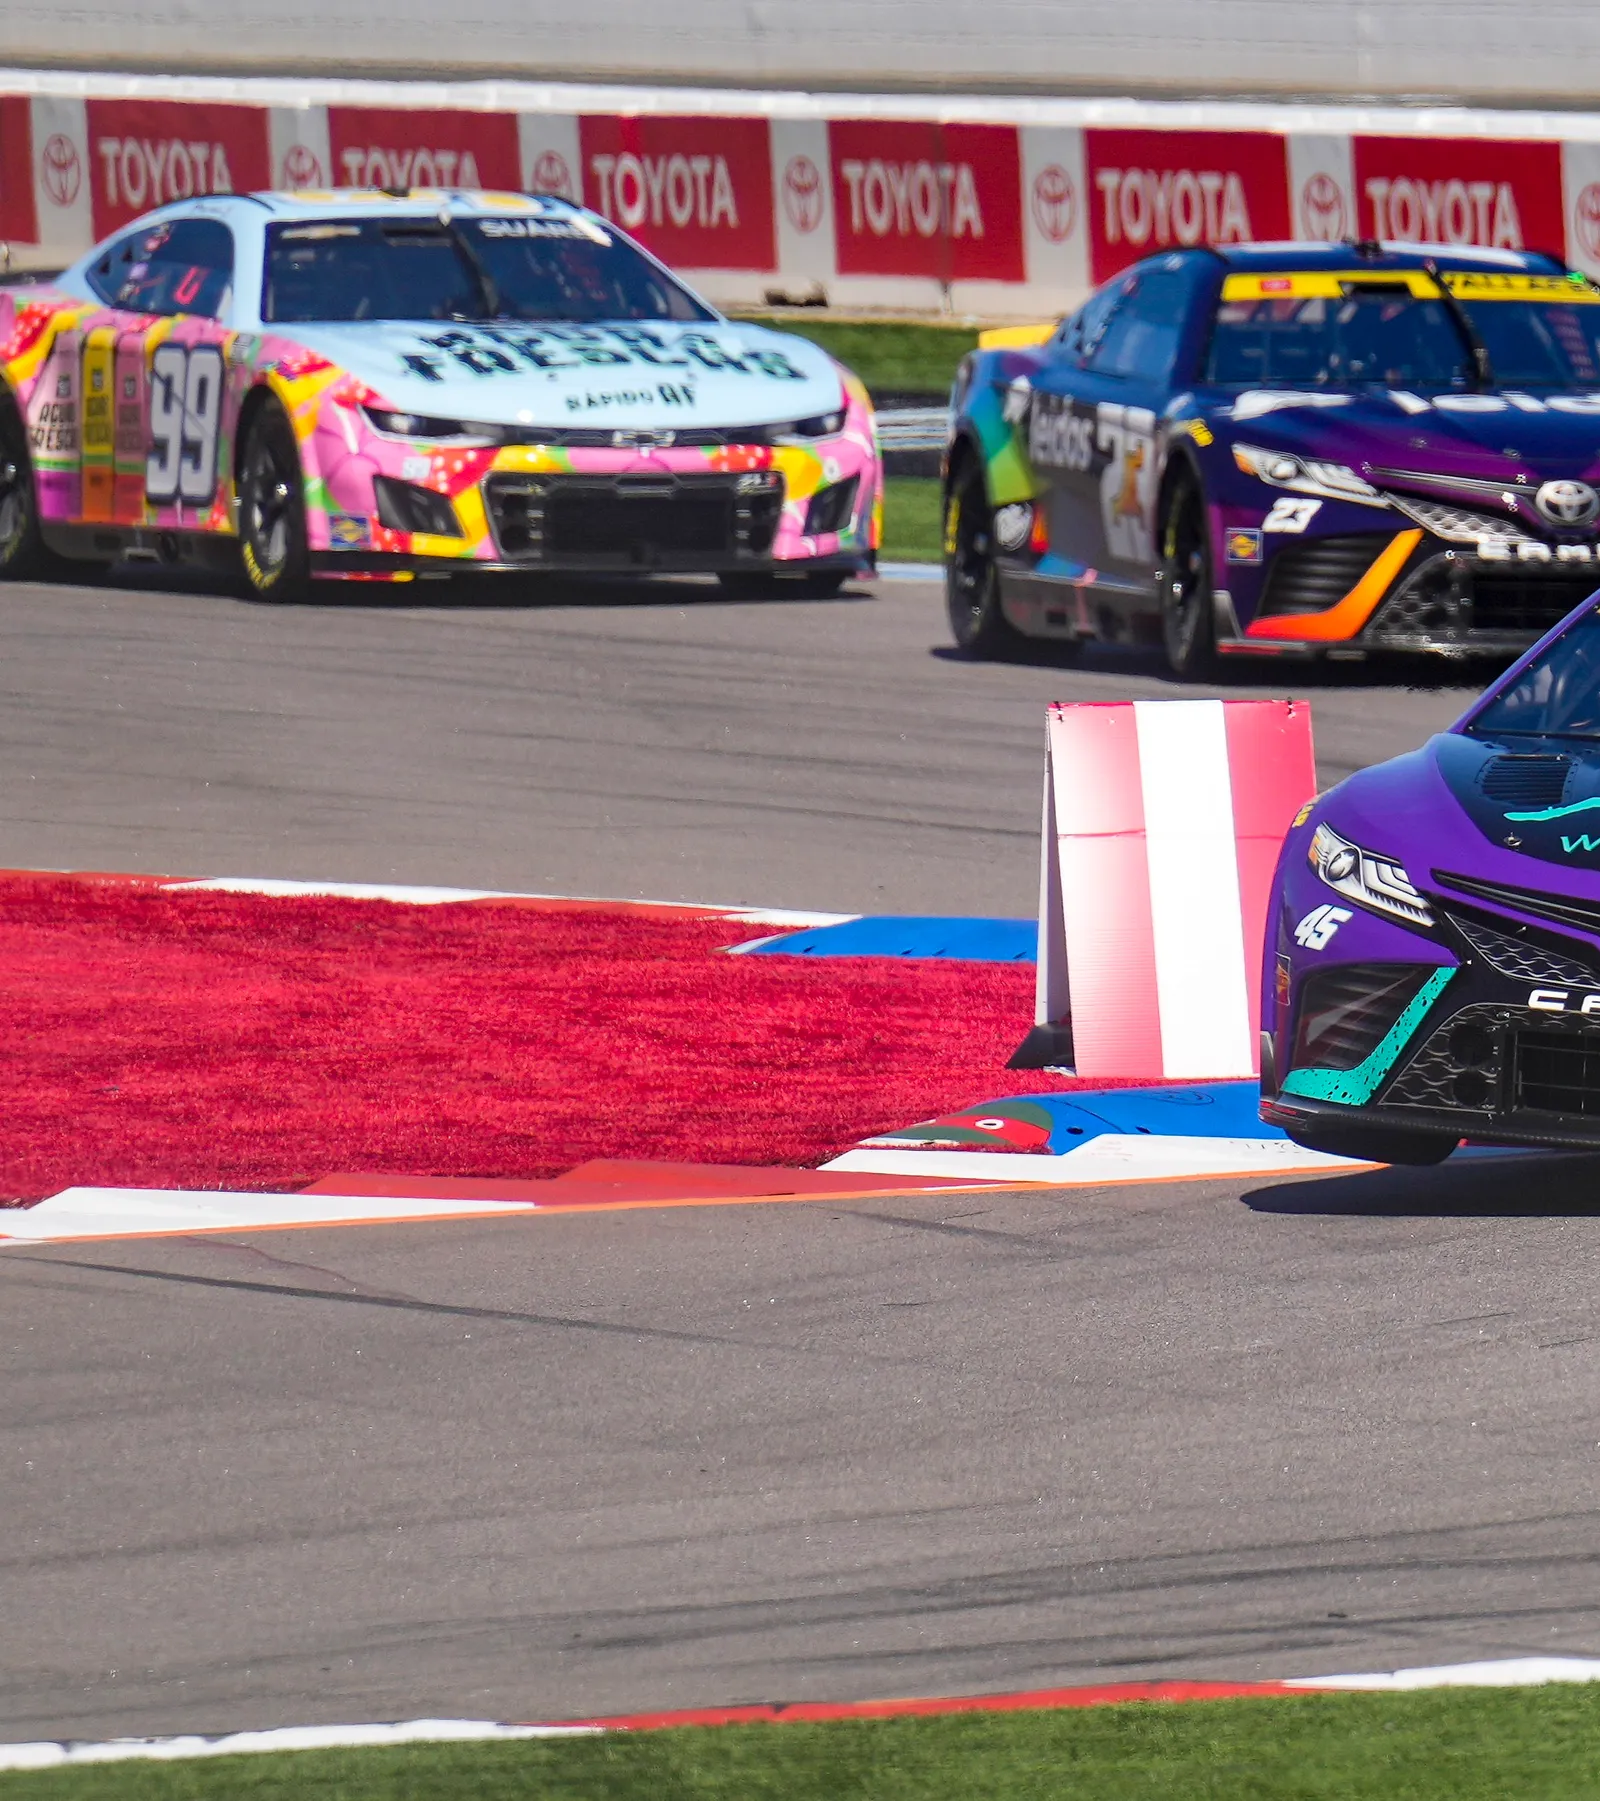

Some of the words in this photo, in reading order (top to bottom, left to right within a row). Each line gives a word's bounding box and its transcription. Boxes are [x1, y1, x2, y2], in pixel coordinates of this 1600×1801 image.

[99, 136, 233, 207] TOYOTA
[341, 146, 482, 191] TOYOTA
[593, 151, 739, 229] TOYOTA
[840, 158, 985, 238] TOYOTA
[1097, 168, 1253, 244] TOYOTA
[1365, 176, 1523, 248] TOYOTA
[146, 343, 225, 503] 99
[1261, 497, 1323, 534] 23
[1294, 903, 1354, 951] 45
